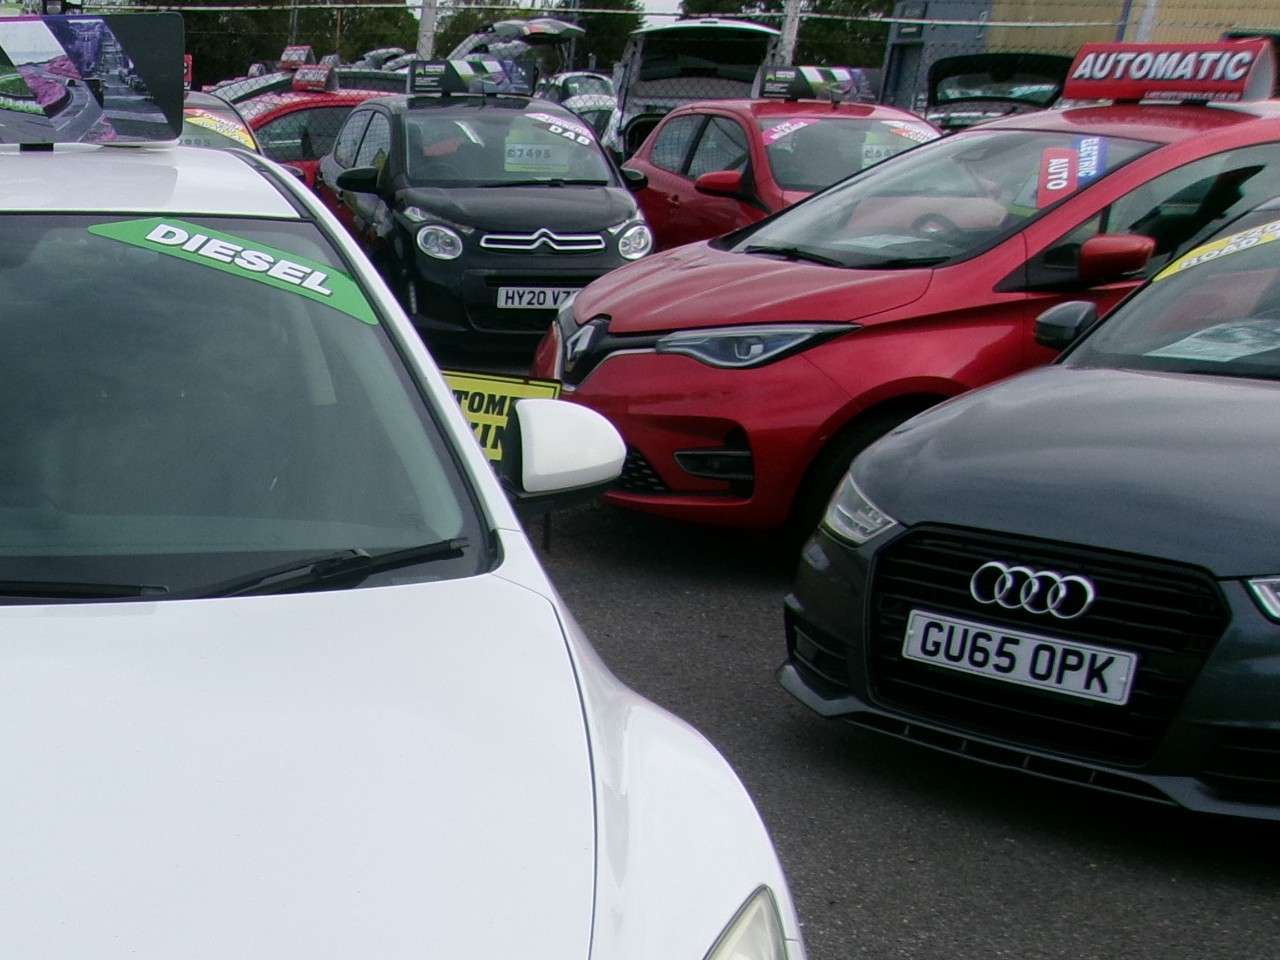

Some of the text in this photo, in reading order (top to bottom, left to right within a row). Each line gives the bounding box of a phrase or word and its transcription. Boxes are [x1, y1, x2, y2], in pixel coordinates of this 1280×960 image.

[1071, 51, 1252, 81] AUTOMATIC
[548, 124, 592, 146] DAB
[1078, 138, 1100, 177] ELECTRIC
[1046, 158, 1069, 190] AUTO
[145, 223, 333, 296] DIESEL
[504, 290, 577, 306] HY20 VZ
[920, 621, 1115, 694] GU65 OPK
